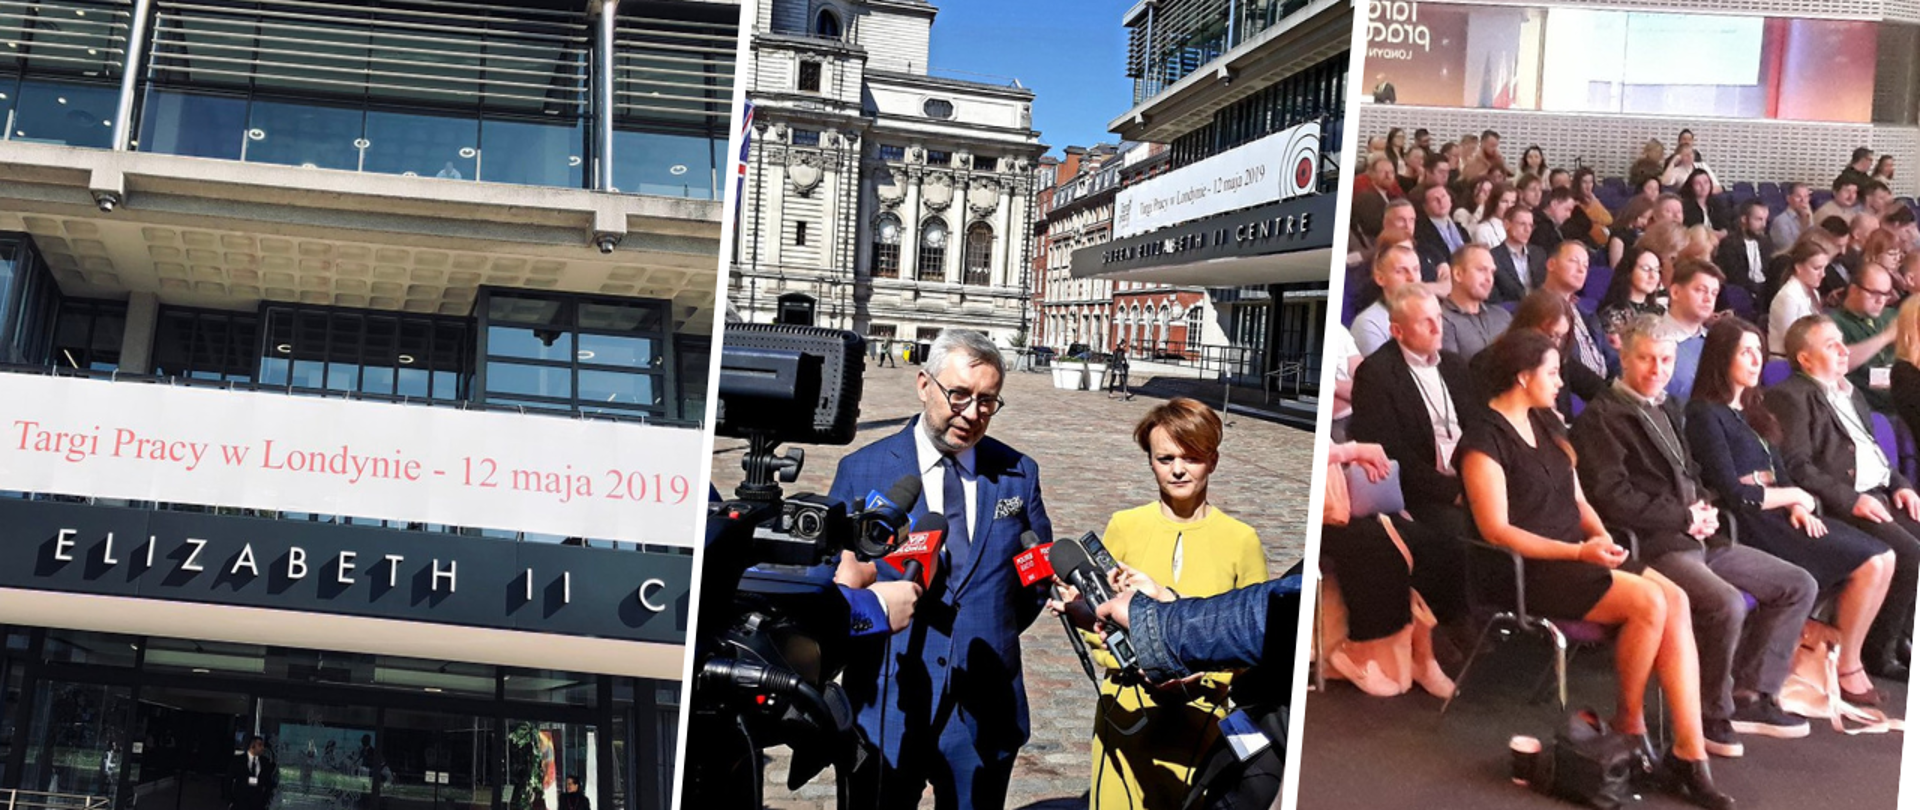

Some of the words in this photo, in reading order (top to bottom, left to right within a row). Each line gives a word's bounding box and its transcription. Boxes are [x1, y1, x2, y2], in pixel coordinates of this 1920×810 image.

[1213, 177, 1222, 194] 12
[1223, 172, 1243, 193] maja
[1244, 164, 1266, 186] 2019
[1101, 245, 1131, 265] QUEEN
[1137, 232, 1203, 258] ELIZABETH
[1235, 211, 1309, 242] CENTRE
[14, 420, 100, 463] Targi
[113, 427, 207, 471] Pracy
[221, 443, 249, 467] w
[262, 438, 421, 484] Londynie
[461, 456, 498, 488] 12
[511, 468, 592, 503] maja
[604, 468, 690, 506] 2019
[54, 527, 457, 592] ELIZABETH
[526, 567, 571, 603] II
